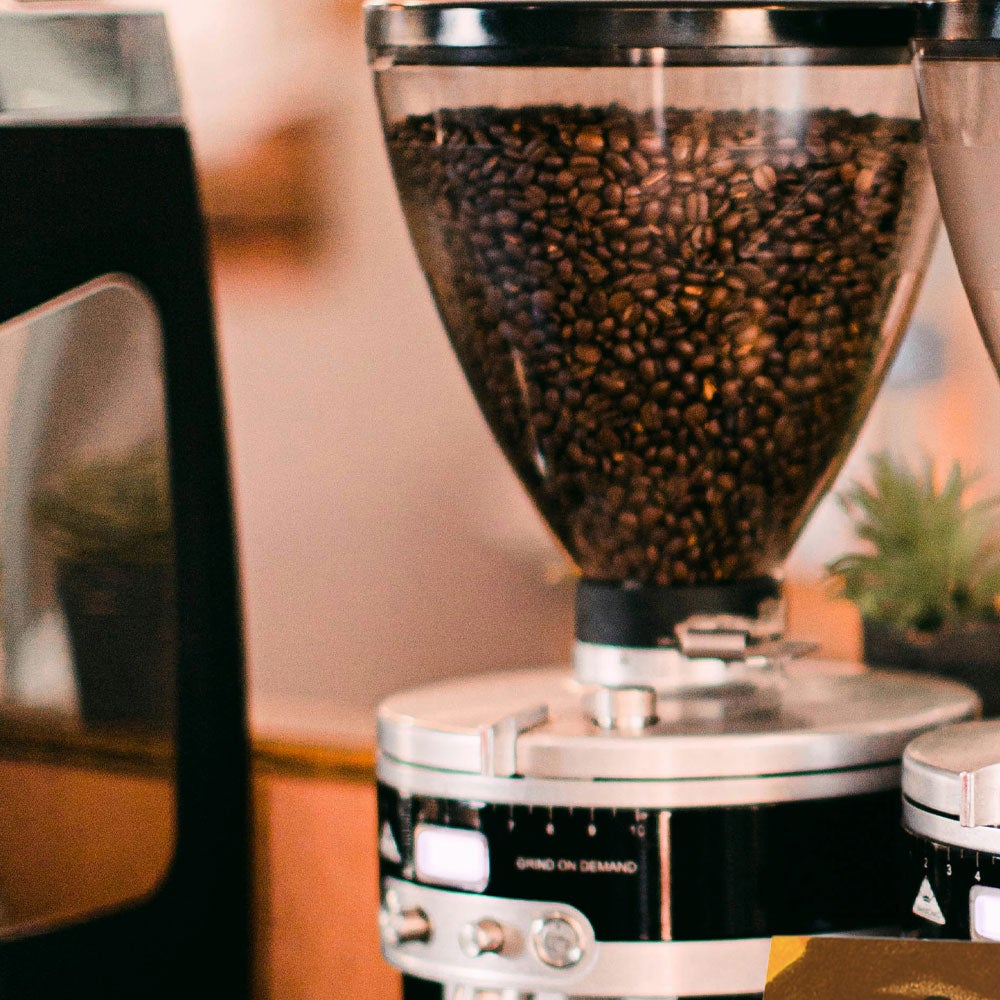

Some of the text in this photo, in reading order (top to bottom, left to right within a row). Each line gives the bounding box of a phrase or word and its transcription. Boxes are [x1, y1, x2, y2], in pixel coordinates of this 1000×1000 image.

[516, 857, 638, 874] GRIND ON DEMAND
[946, 864, 952, 876] 3
[975, 871, 981, 882] 4
